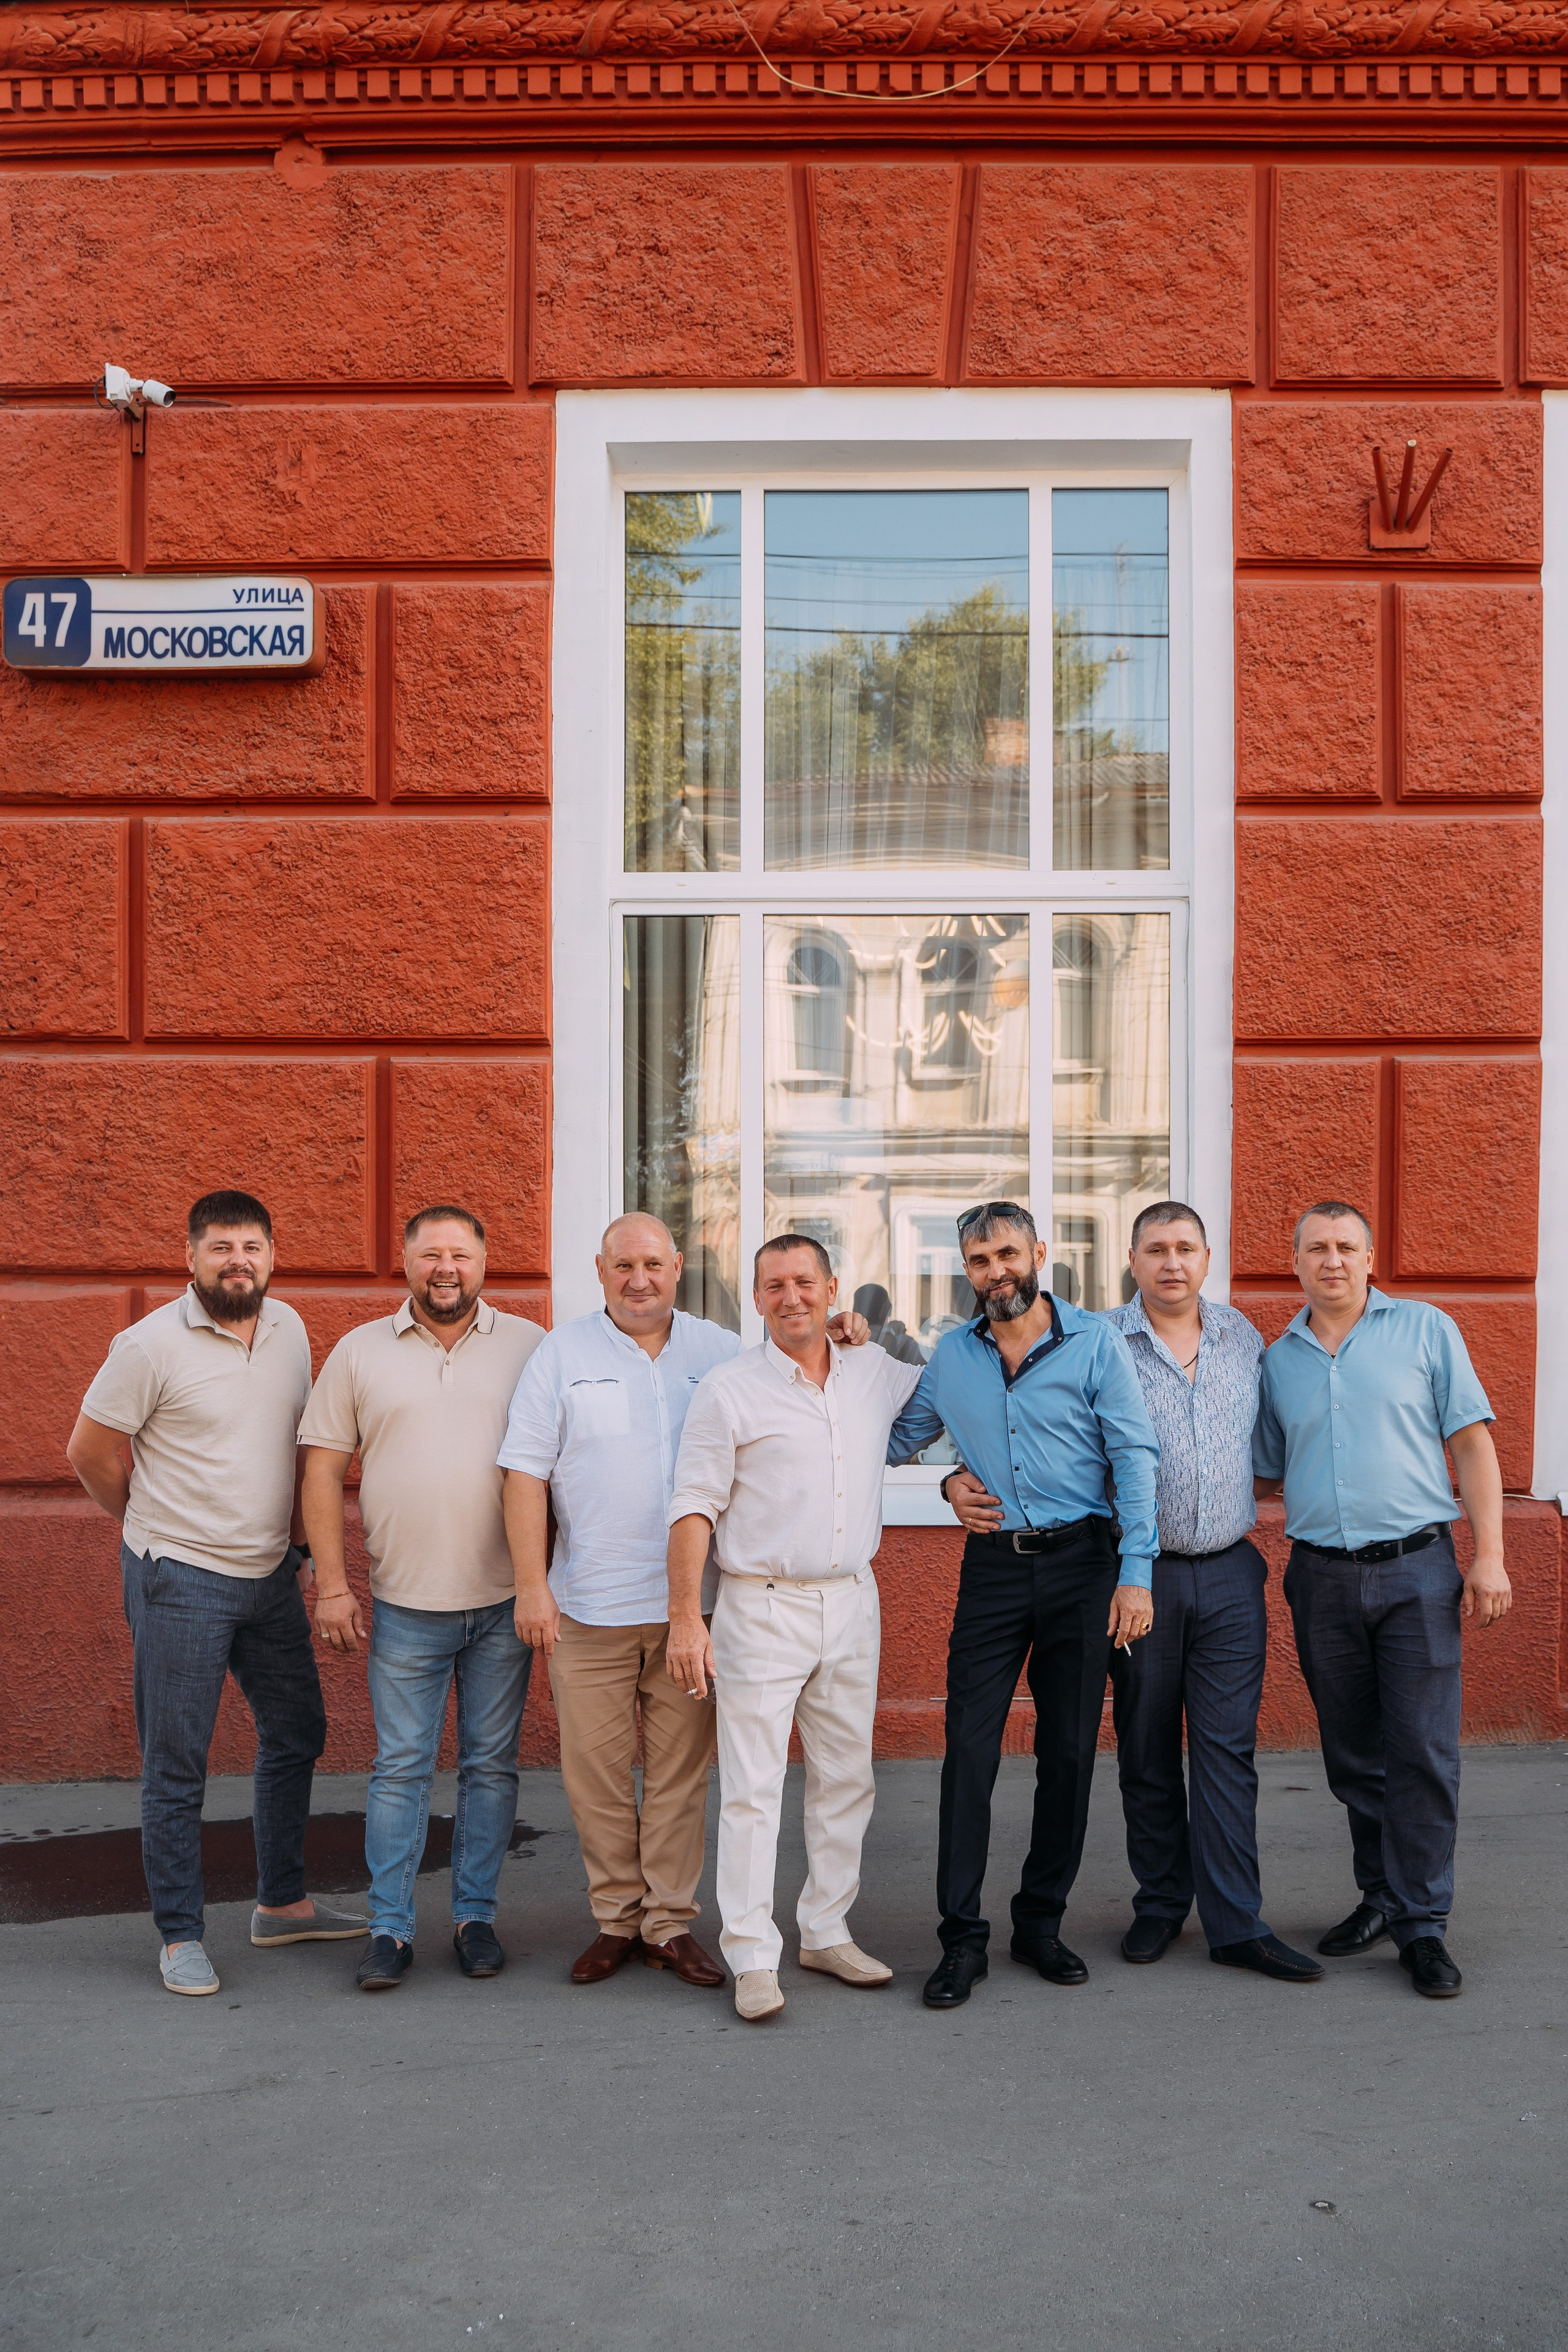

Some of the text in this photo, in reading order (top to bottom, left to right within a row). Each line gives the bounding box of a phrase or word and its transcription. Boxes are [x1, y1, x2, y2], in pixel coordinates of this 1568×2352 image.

[232, 587, 304, 604] УЛИЦА
[18, 592, 78, 647] 47
[104, 625, 304, 658] МОСКОВСКАЯ
